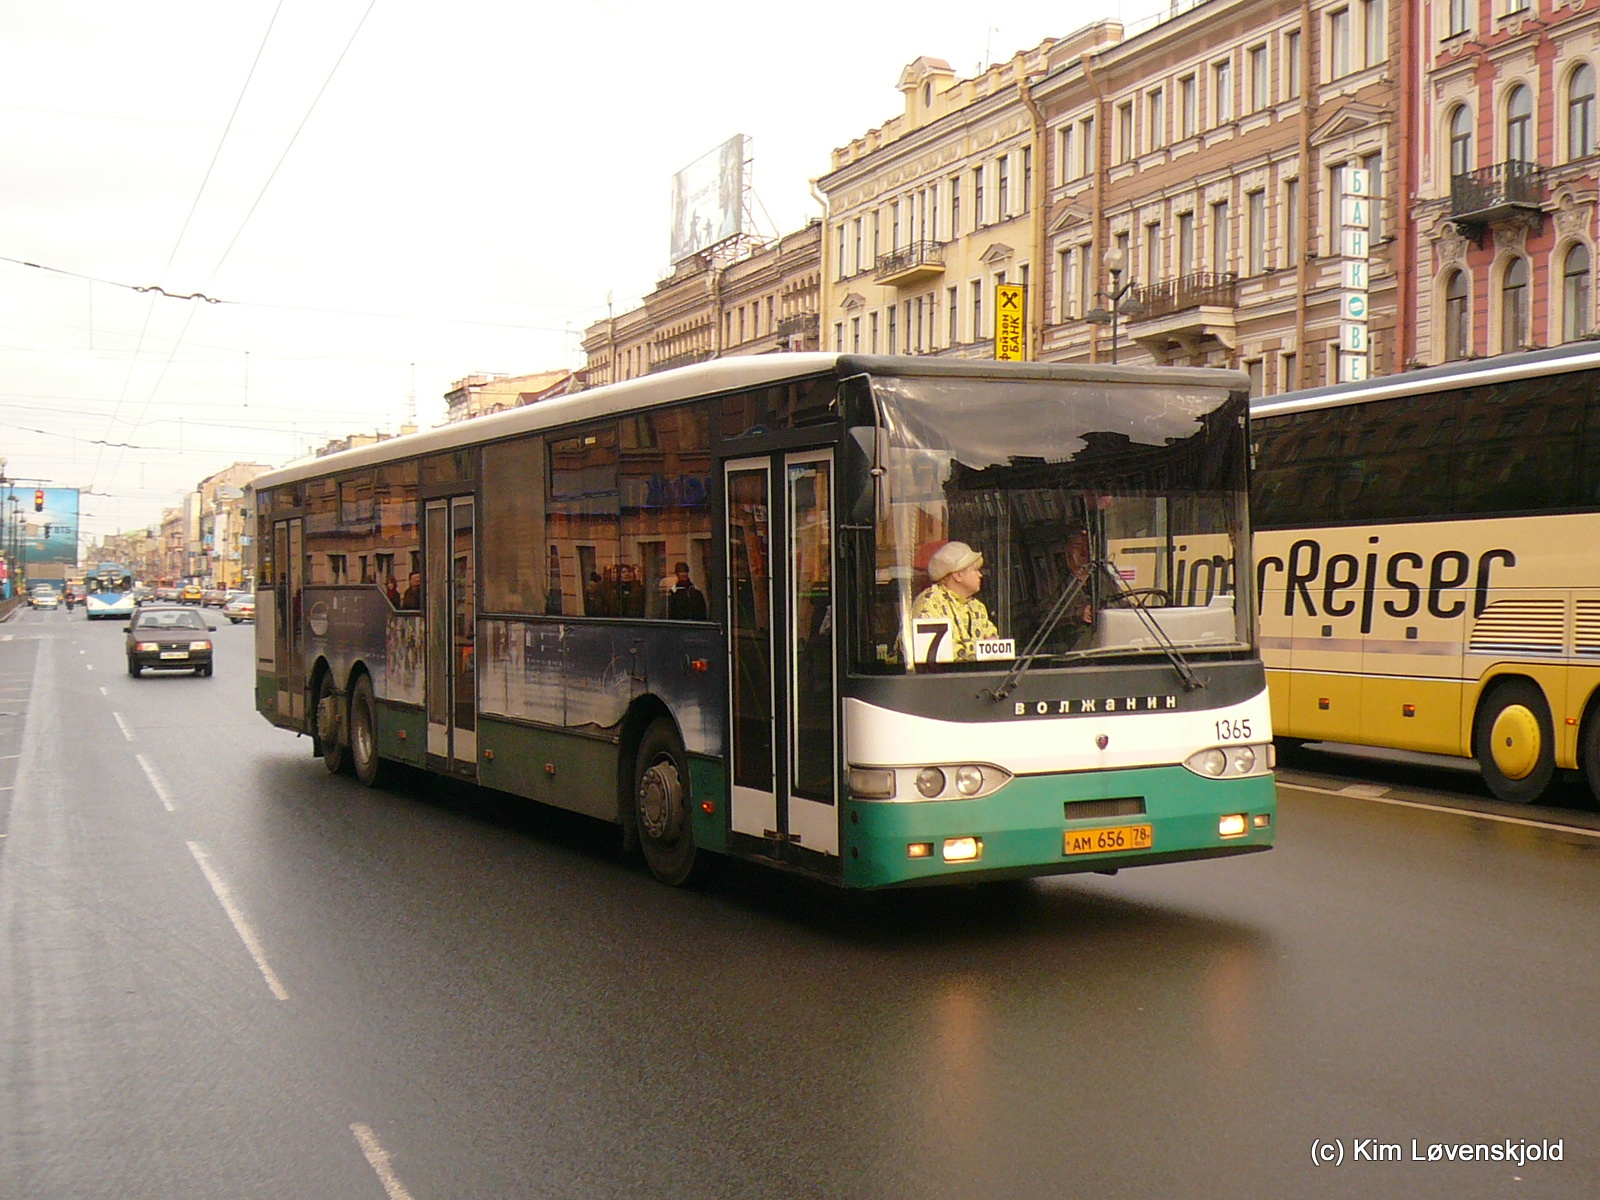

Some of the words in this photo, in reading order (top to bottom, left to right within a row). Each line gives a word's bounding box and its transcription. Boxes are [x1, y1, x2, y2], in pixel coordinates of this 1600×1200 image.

[1009, 315, 1020, 353] БАНК
[917, 623, 949, 664] 7
[979, 642, 1012, 655] ТОСОЛ
[1215, 719, 1252, 741] 1365
[1097, 830, 1125, 849] 656
[1132, 828, 1147, 841] 78
